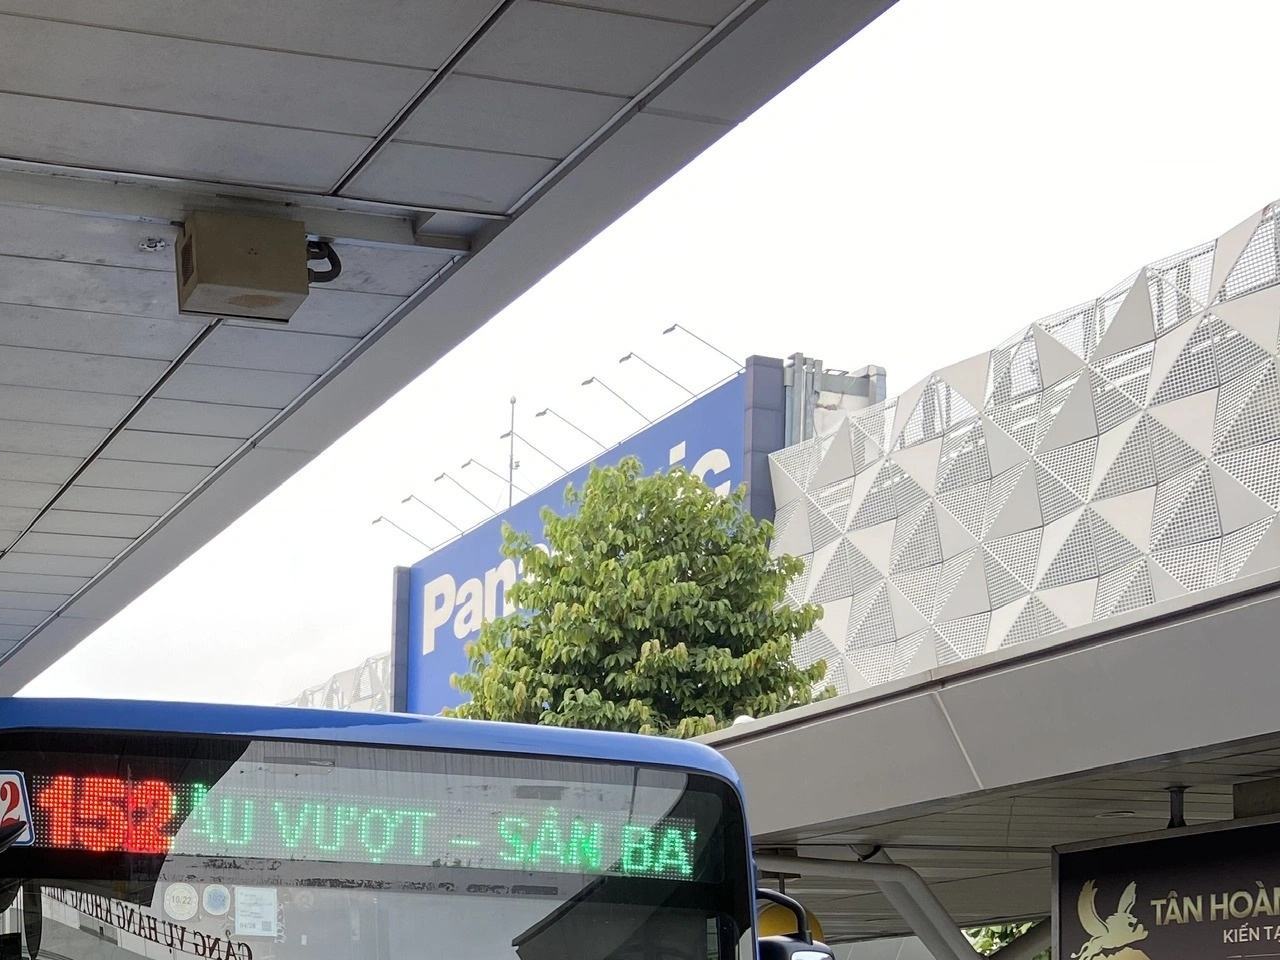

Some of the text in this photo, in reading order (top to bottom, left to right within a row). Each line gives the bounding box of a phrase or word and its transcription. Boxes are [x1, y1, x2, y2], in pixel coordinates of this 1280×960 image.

[40, 775, 173, 852] 152
[621, 824, 697, 876] BA
[1150, 890, 1204, 926] TÂN
[1223, 922, 1260, 944] KIẾN
